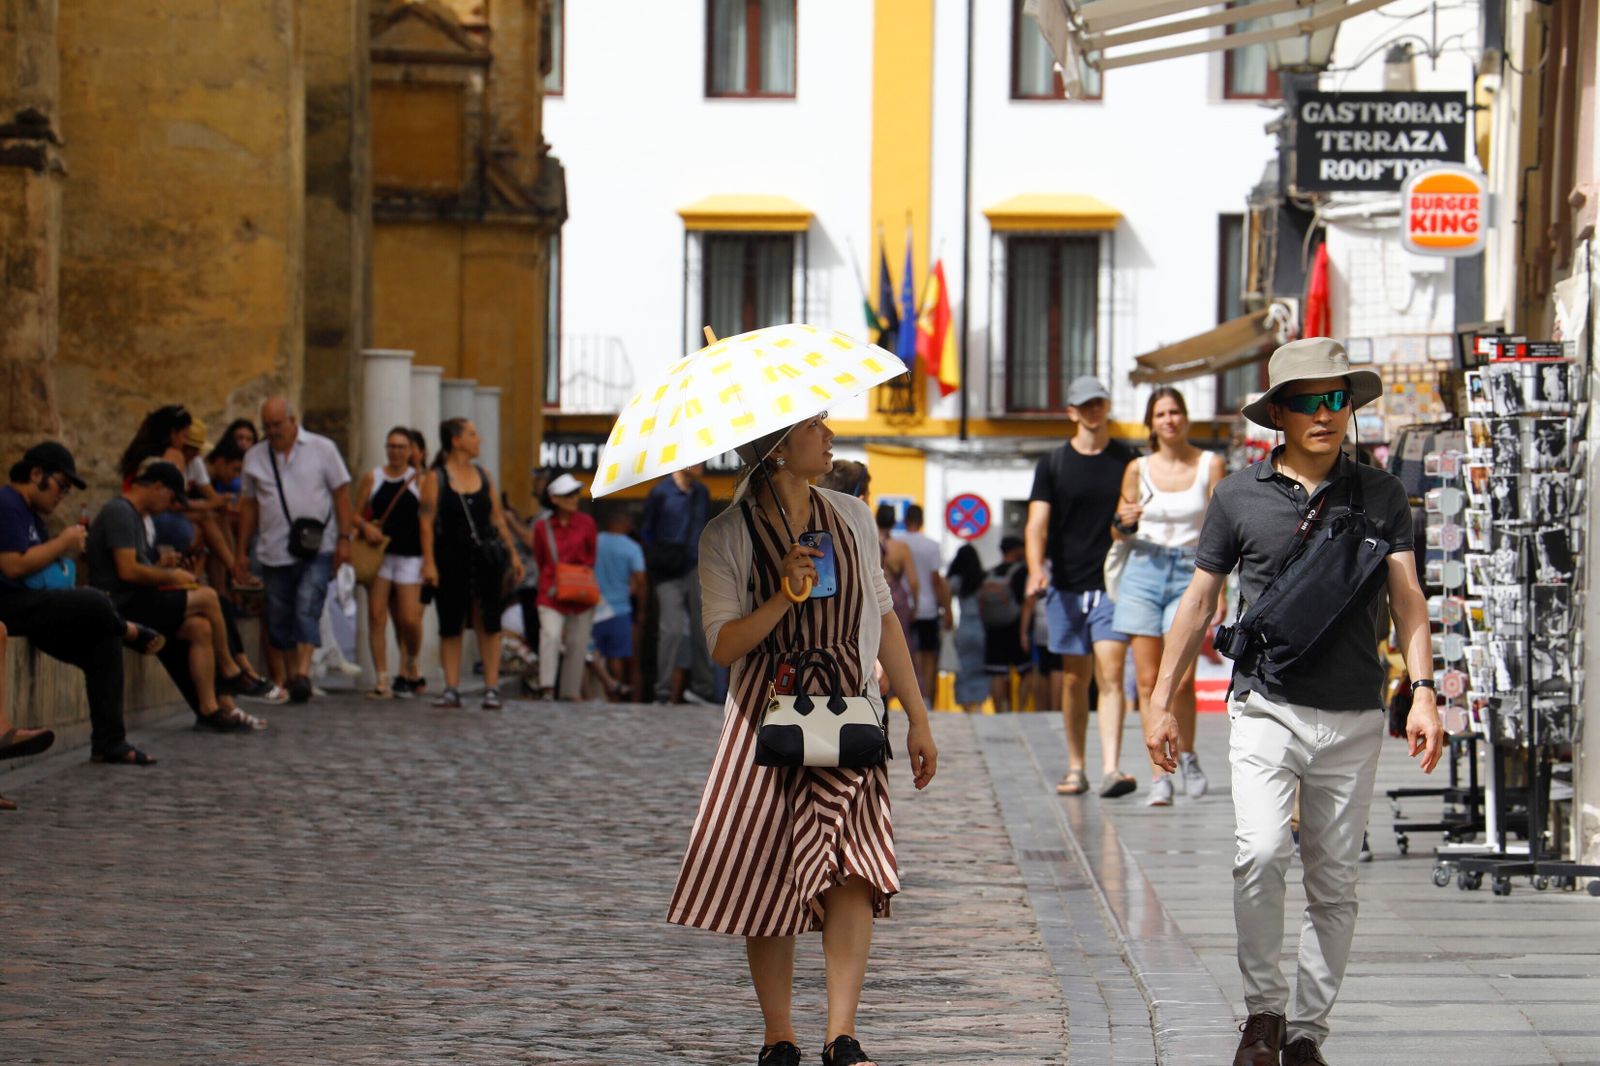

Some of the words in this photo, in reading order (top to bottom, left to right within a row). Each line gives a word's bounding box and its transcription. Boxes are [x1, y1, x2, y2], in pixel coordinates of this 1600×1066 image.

[1301, 101, 1464, 124] GASTROBAR
[1315, 130, 1448, 152] TERRAZA
[1319, 158, 1440, 180] ROOFTO
[1410, 196, 1479, 211] BURGER
[1410, 213, 1478, 233] KING
[1300, 509, 1316, 531] Caon
